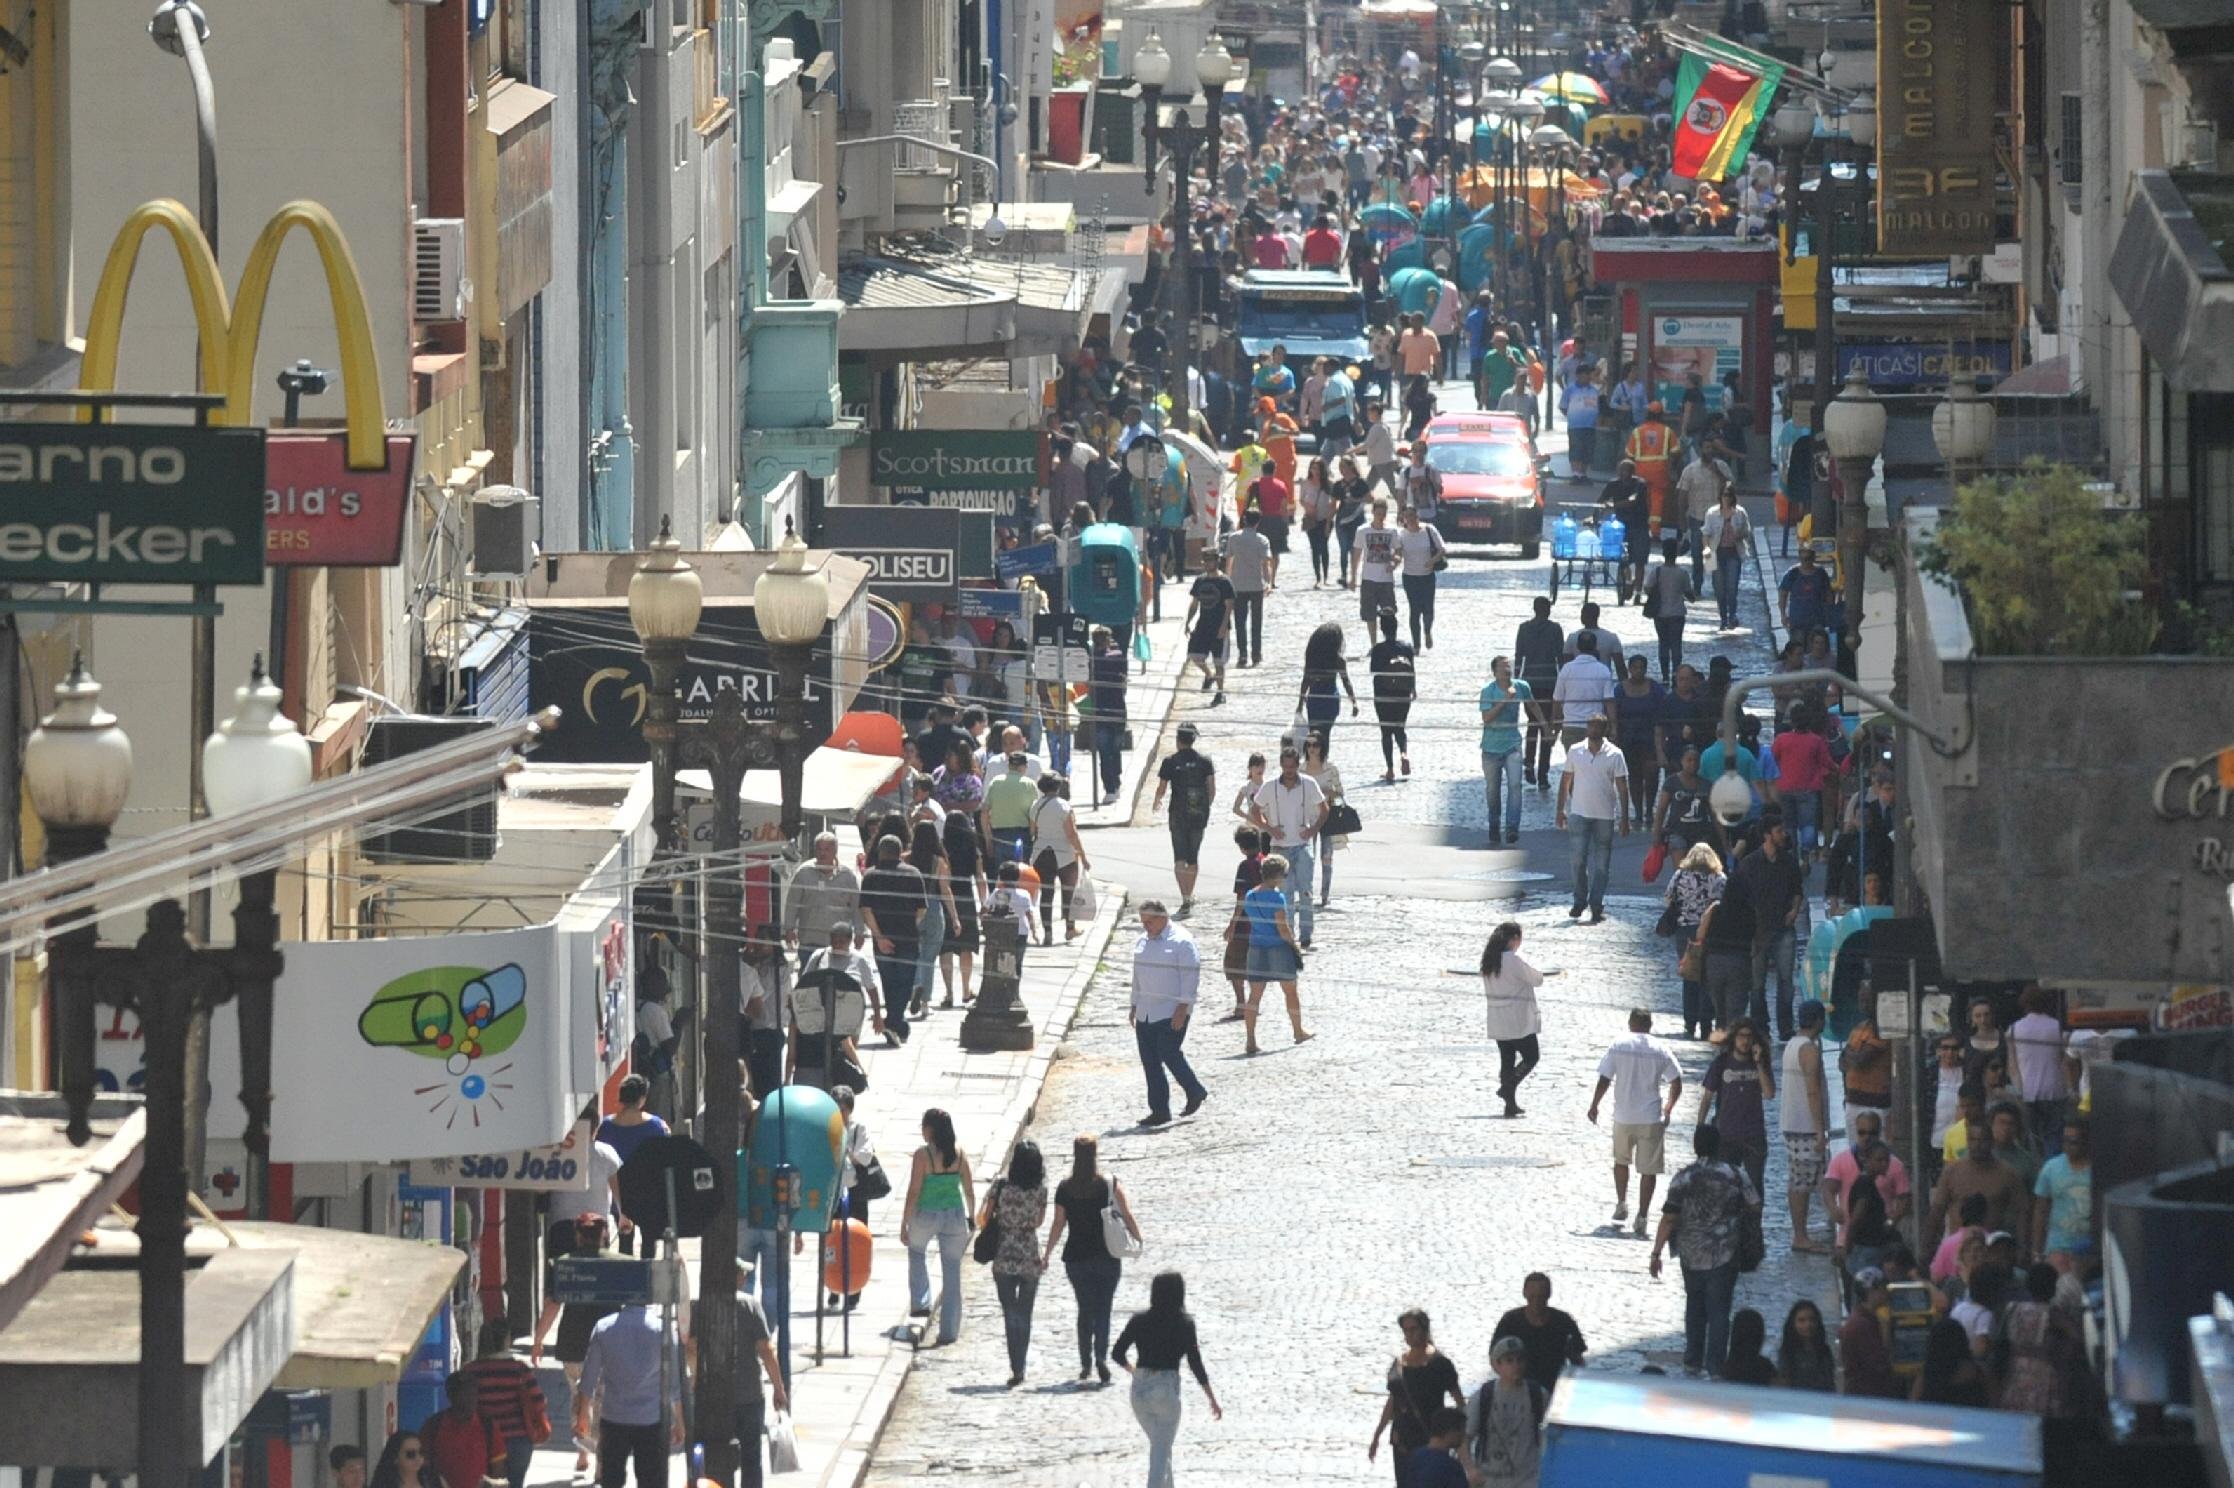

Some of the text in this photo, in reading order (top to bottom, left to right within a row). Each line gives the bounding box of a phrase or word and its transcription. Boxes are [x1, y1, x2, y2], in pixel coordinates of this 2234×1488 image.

[1887, 212, 1990, 231] MALCON
[1465, 423, 1485, 432] TAXI
[876, 447, 1036, 478] Scotsman
[0, 512, 235, 564] ecker
[850, 555, 947, 579] OLISEU
